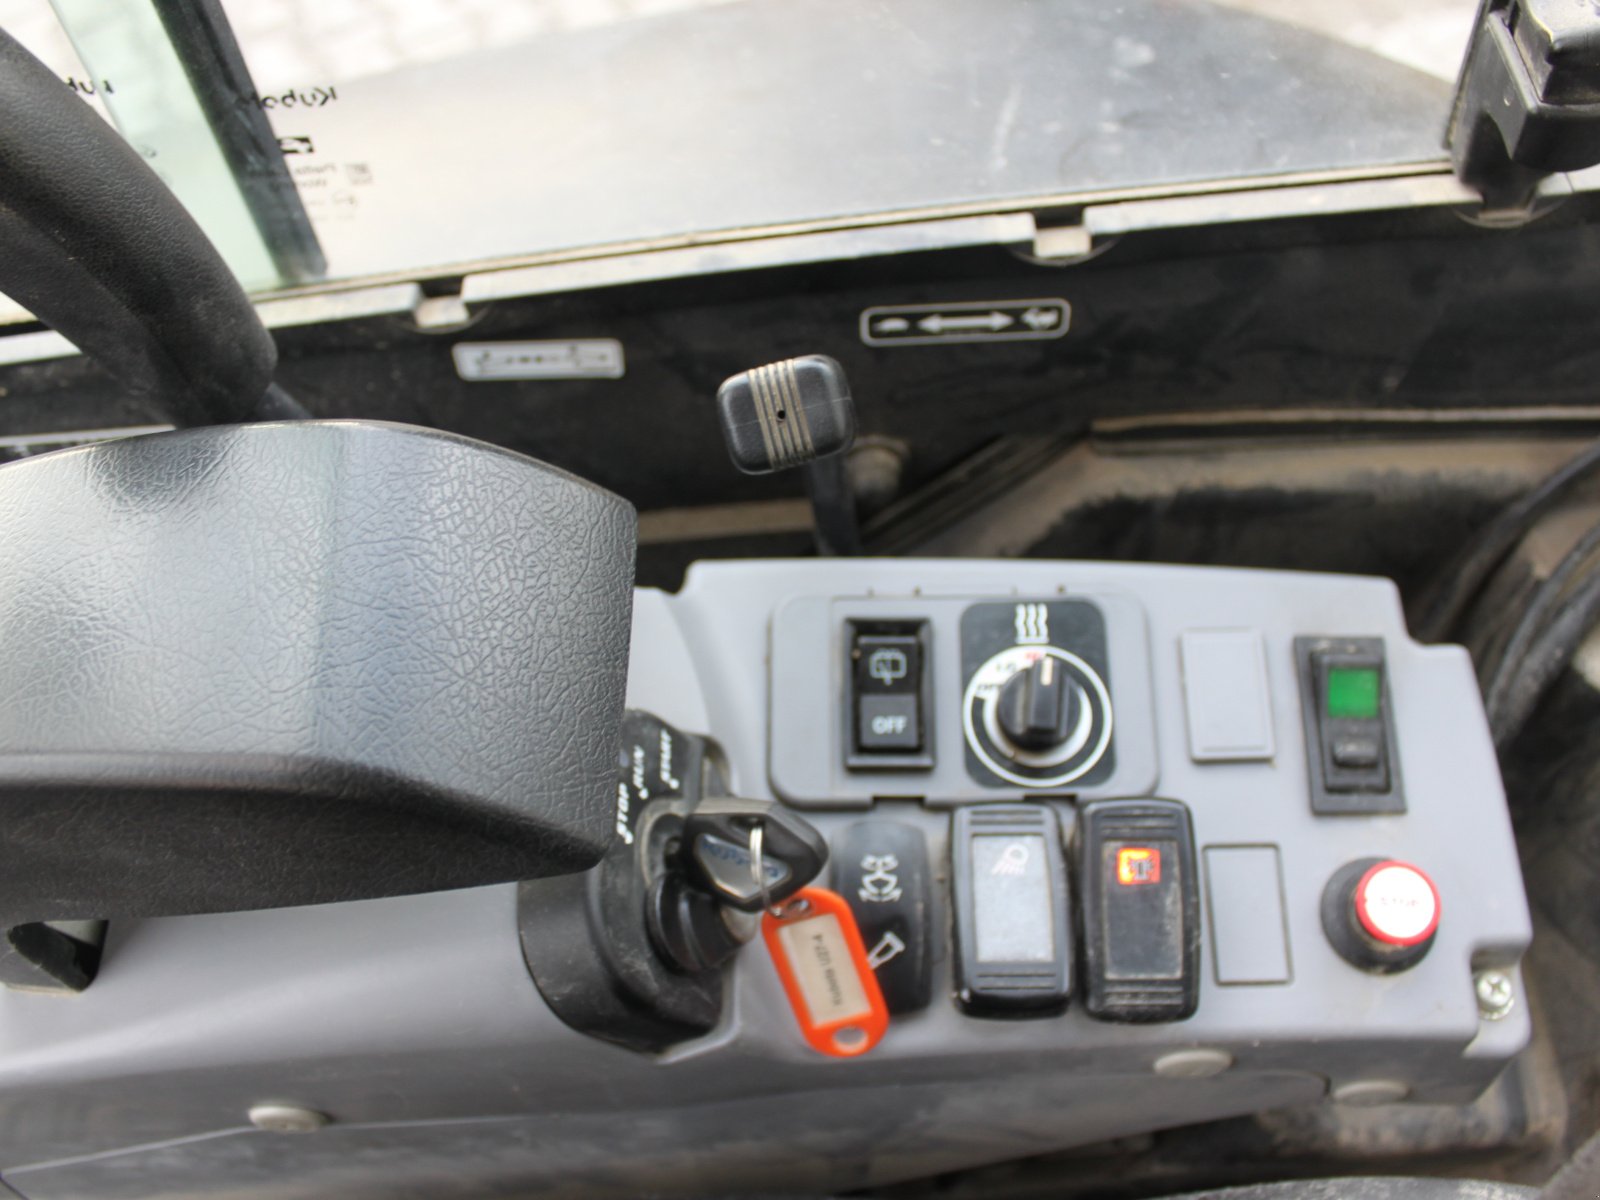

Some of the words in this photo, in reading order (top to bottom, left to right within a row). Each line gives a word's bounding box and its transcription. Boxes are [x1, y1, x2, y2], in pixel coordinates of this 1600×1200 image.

[871, 714, 908, 735] OFF
[632, 745, 645, 788] RUN
[616, 781, 630, 838] STOP
